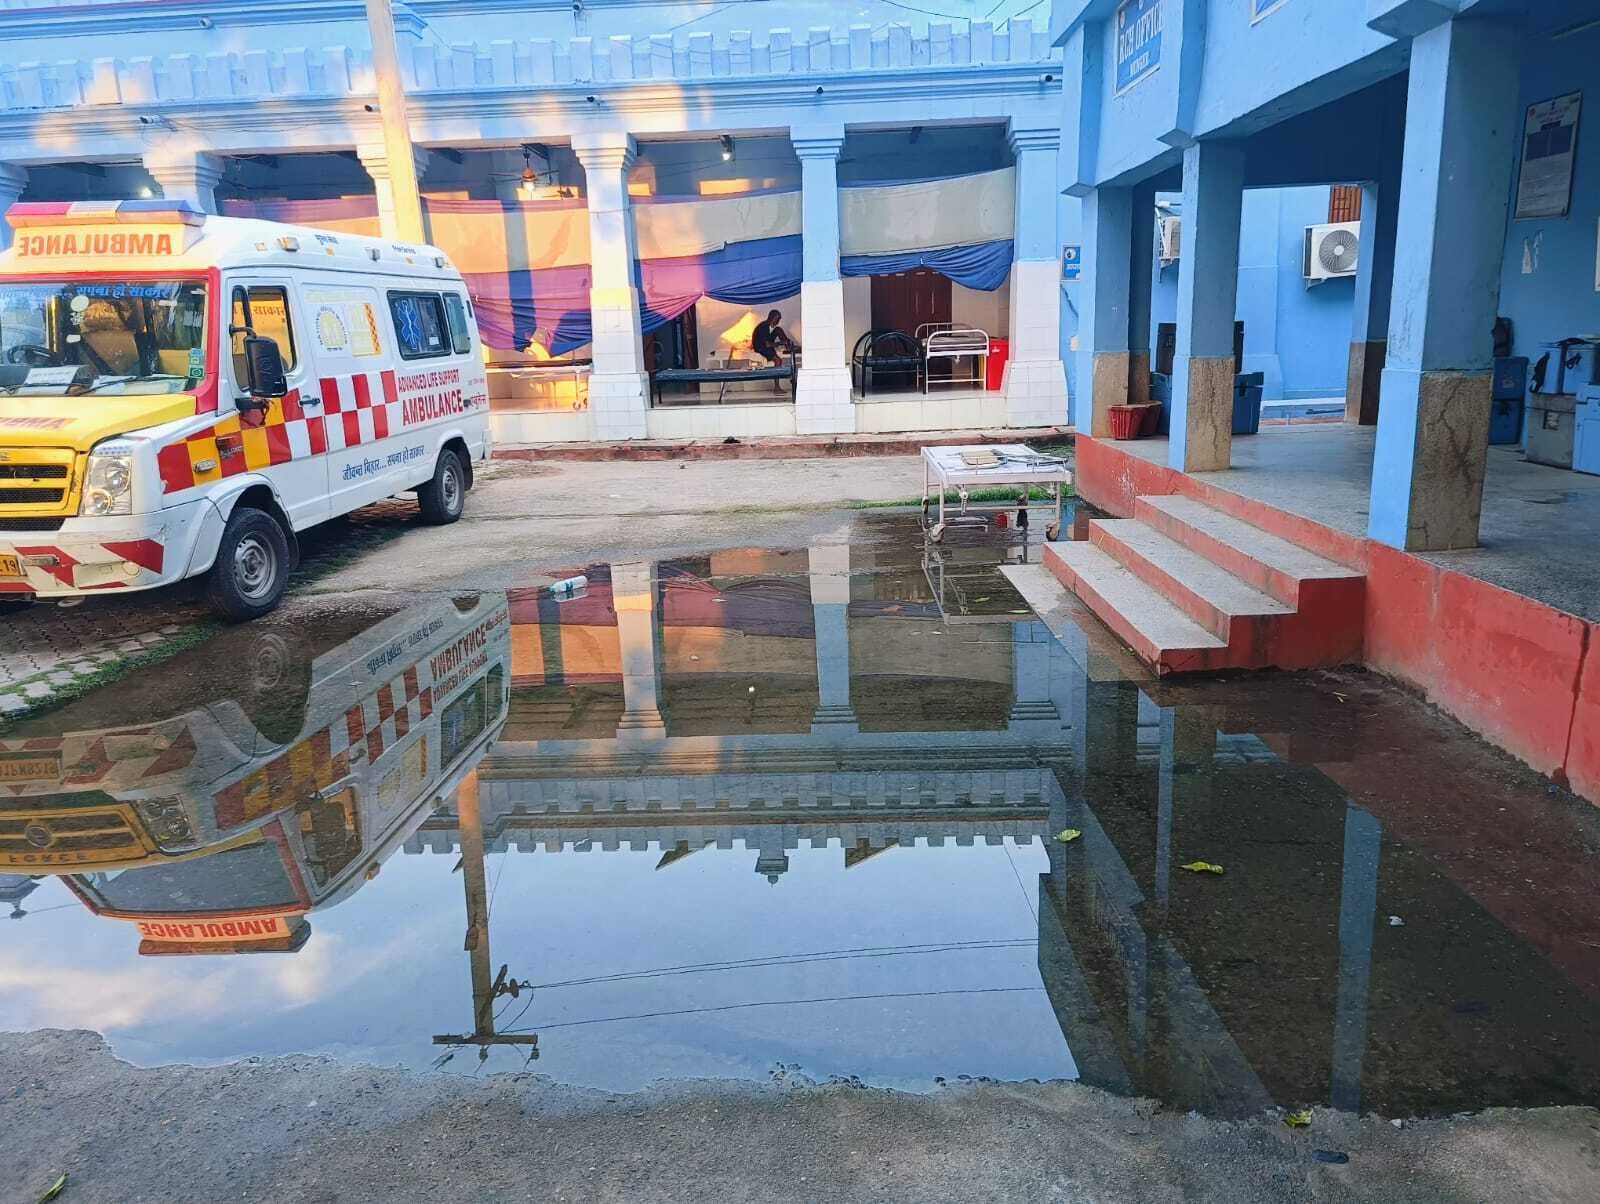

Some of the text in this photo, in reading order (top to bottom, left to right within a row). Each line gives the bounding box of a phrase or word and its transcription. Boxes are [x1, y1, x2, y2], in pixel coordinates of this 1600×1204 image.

[398, 375, 427, 393] ADVANCED
[425, 370, 439, 388] LIFE
[437, 368, 460, 386] SUPPORT
[402, 389, 464, 426] AMBULANCE
[142, 917, 278, 938] AMBULANCE
